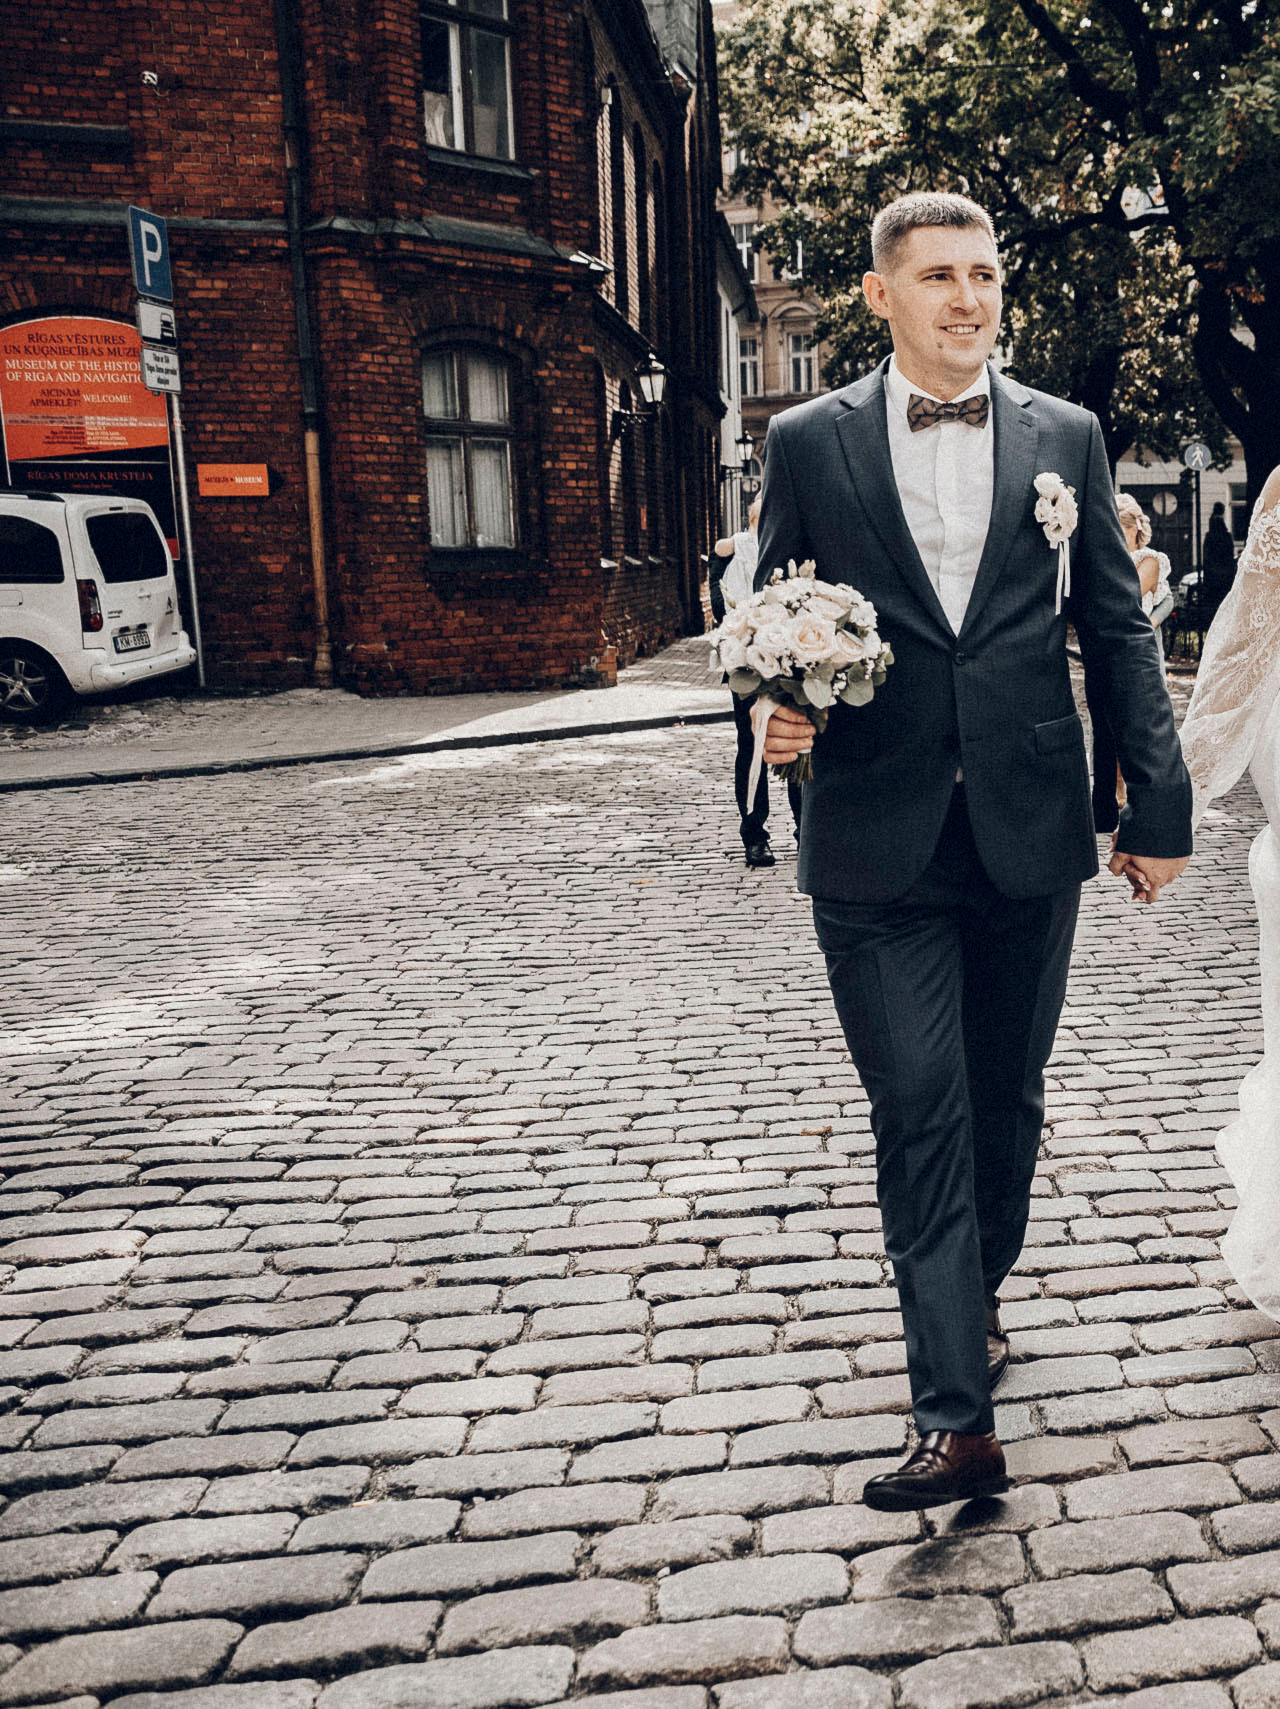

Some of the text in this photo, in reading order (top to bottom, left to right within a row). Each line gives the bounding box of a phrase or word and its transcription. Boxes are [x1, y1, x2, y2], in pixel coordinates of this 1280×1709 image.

[139, 219, 163, 287] P
[27, 332, 126, 345] RĪGAS VĒSTURES
[3, 344, 21, 354] UN
[107, 346, 140, 357] MUZE
[5, 359, 57, 370] MUSEUM
[60, 360, 76, 370] OF
[78, 360, 101, 371] THE
[103, 361, 141, 372] HISTO
[5, 371, 22, 381] OF
[24, 371, 54, 382] RIGA
[55, 372, 81, 382] AND
[82, 393, 132, 404] WELCOME!
